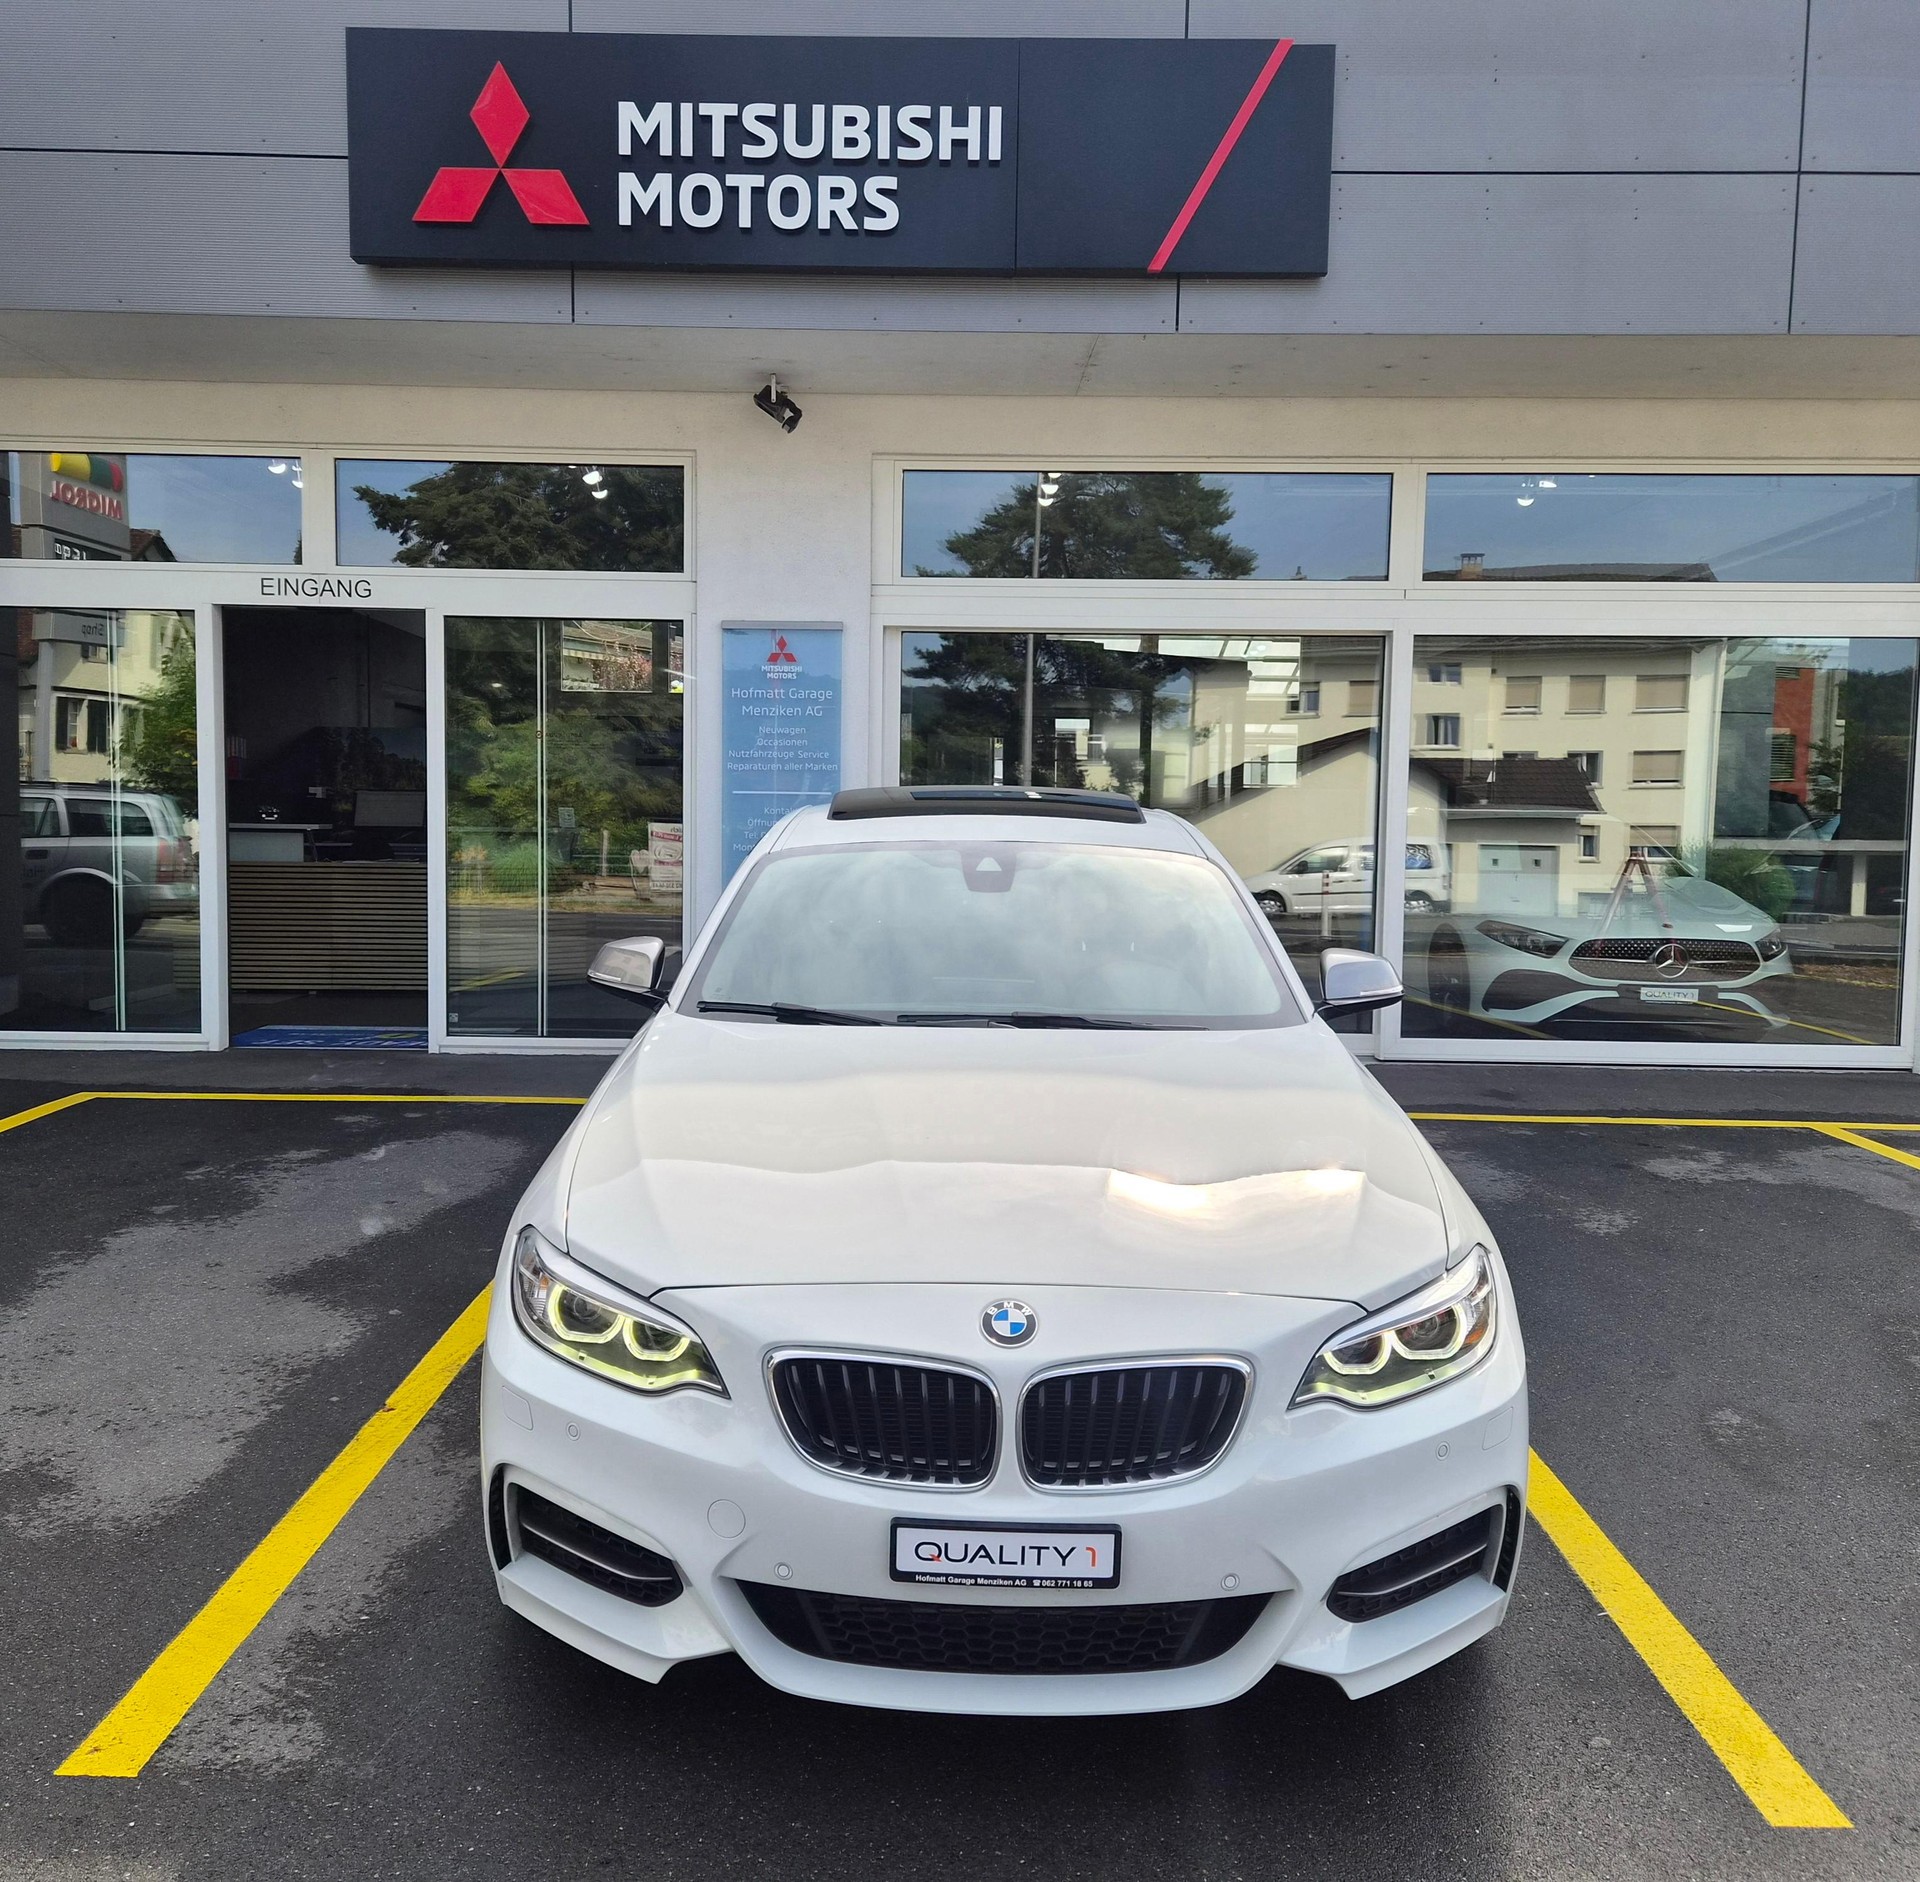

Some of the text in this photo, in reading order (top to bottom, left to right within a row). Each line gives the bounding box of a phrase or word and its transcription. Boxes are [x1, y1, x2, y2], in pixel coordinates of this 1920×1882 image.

[617, 101, 1003, 161] MITSUBISHI
[617, 172, 900, 231] MOTORS
[261, 577, 372, 599] EINGANG
[761, 665, 803, 673] MITSUBISHI
[767, 672, 797, 680] MOTORS
[731, 687, 833, 702] Hofmatt Garage
[741, 705, 823, 717] Menziken AG
[758, 726, 807, 736] Neuwagen
[757, 738, 808, 747] Occasionen
[728, 750, 830, 761] Nutzfahrzeuge Service
[727, 762, 838, 772] Reparaturen aller Marken
[986, 1300, 1033, 1316] BMW
[914, 1541, 1097, 1567] QUALITY 1
[915, 1574, 946, 1583] Hofmatt
[947, 1576, 976, 1586] Garage
[977, 1577, 1013, 1586] Menziken
[1014, 1578, 1027, 1587] AG
[1041, 1579, 1056, 1587] 062
[1057, 1579, 1071, 1587] 771
[1072, 1580, 1082, 1588] 18
